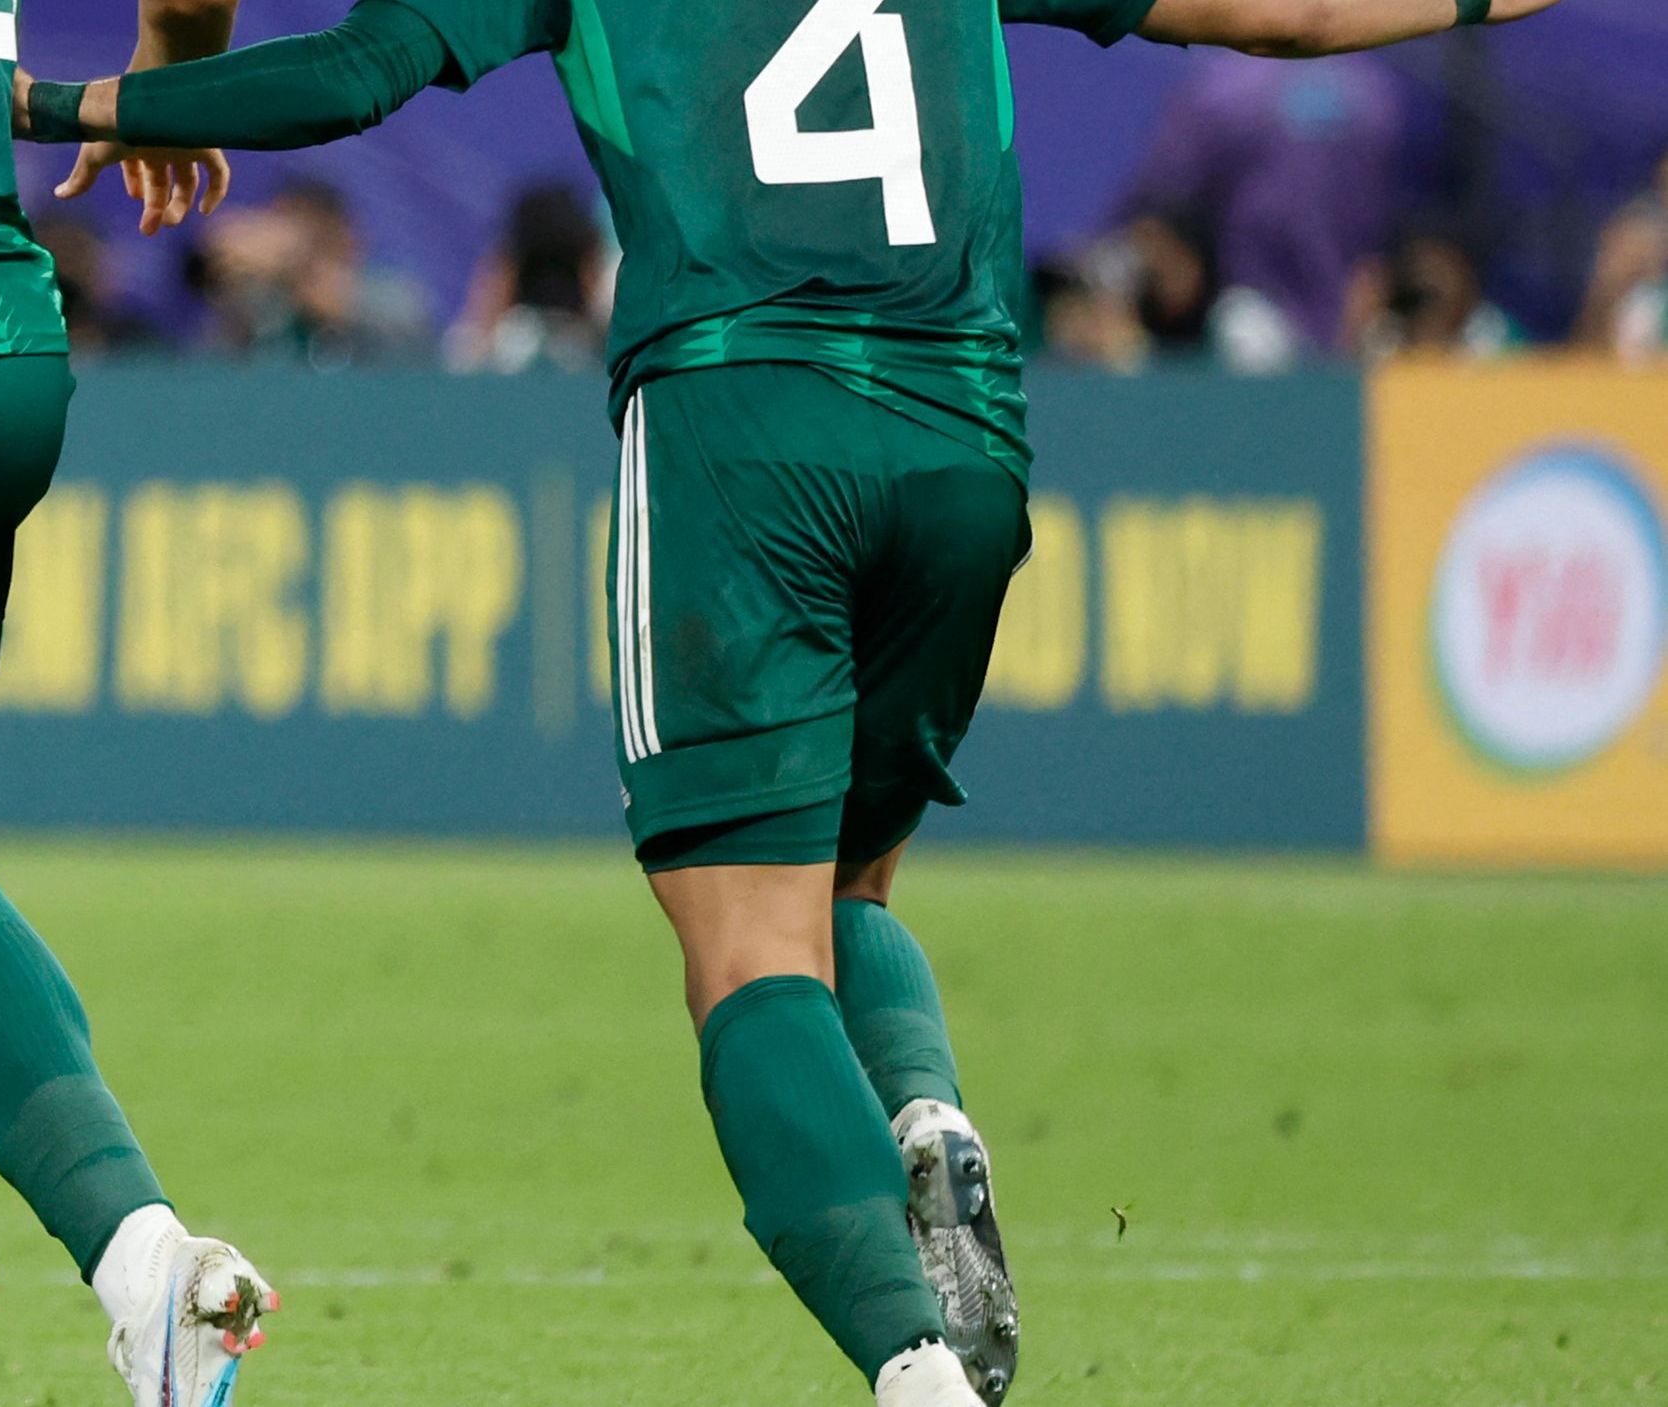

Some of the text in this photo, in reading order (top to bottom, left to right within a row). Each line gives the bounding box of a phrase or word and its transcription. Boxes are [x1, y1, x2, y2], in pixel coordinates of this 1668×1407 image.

[114, 477, 311, 717] AFC
[319, 477, 524, 717] APP
[1098, 492, 1324, 712] NOW
